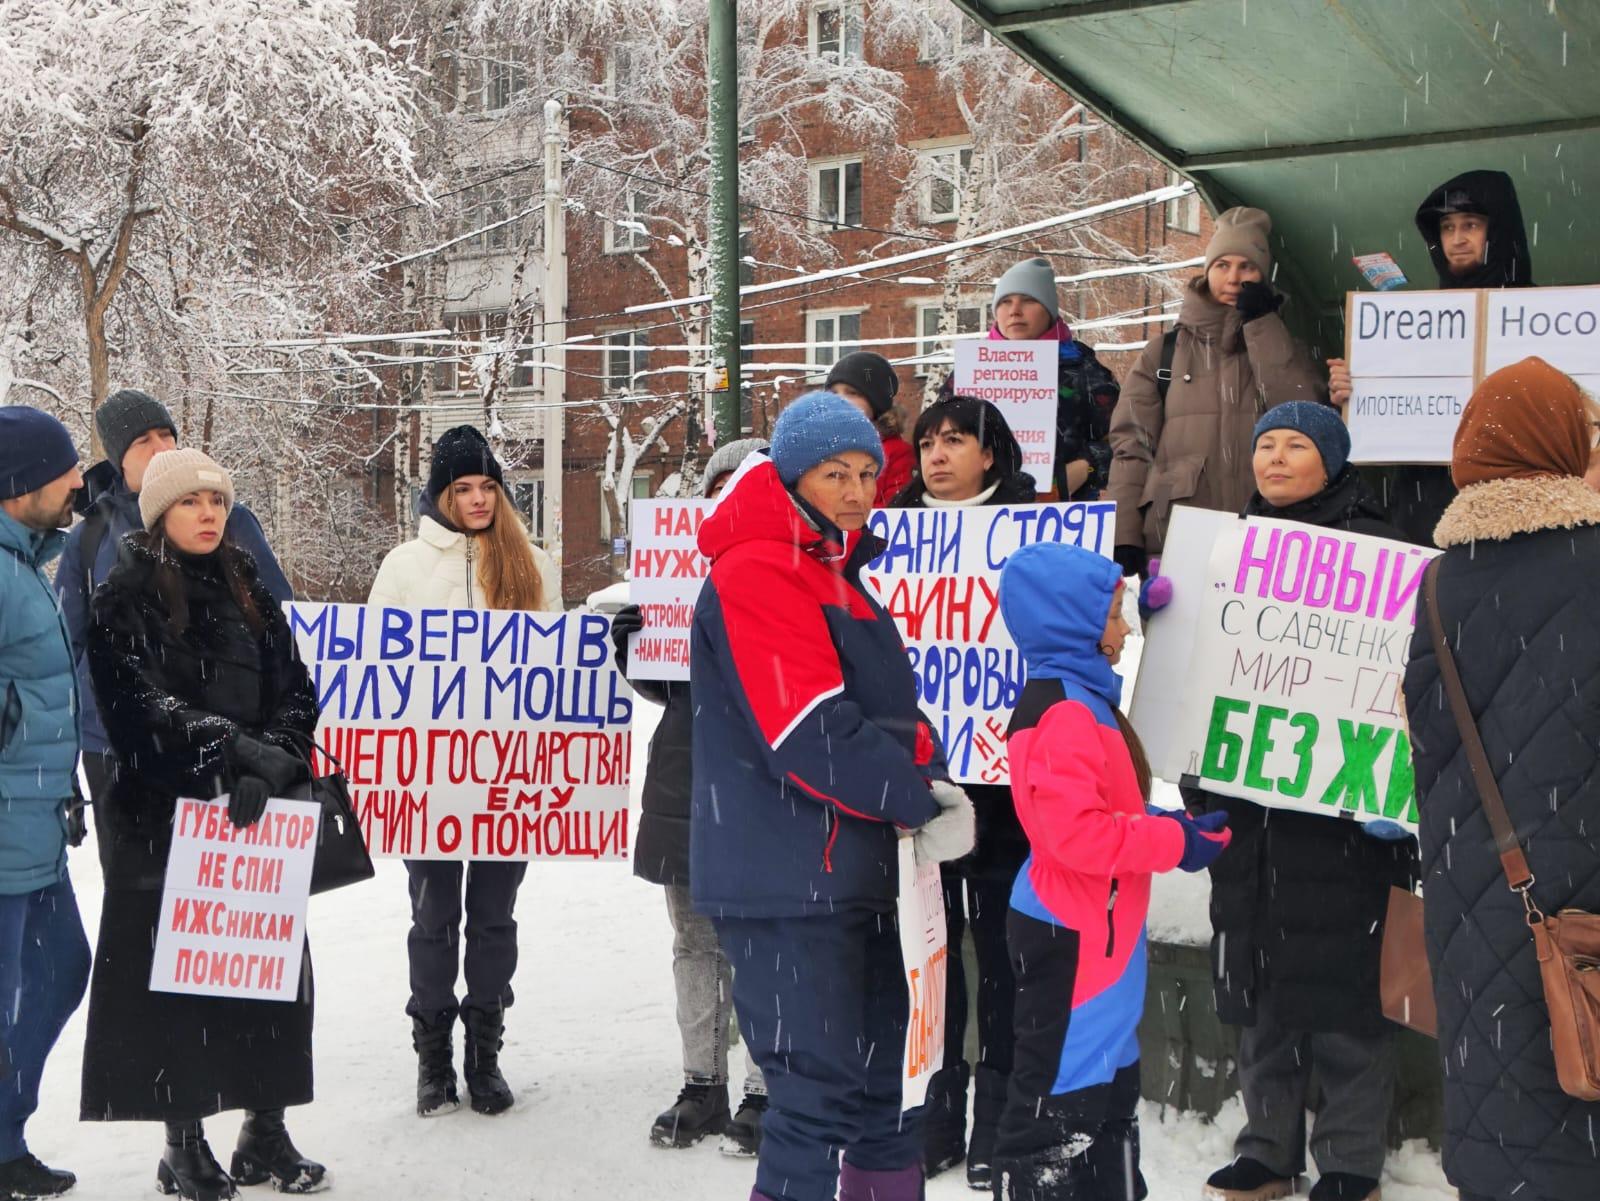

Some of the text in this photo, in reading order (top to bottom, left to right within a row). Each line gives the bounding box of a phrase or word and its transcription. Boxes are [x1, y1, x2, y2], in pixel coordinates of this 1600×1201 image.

[1359, 301, 1466, 340] Dream
[978, 347, 1034, 363] Власти
[956, 387, 1056, 403] игнорируют
[973, 369, 1038, 385] региона
[1356, 395, 1462, 417] ИПОТЕКА ЕСТЬ
[986, 503, 1116, 571] СТОЯТ
[639, 597, 694, 628] ОСТРОЙКА
[1221, 600, 1245, 636] С
[290, 605, 611, 668] МЫ ВЕРИМ В
[664, 637, 690, 667] НЕГД
[314, 664, 633, 729] ИЛУ И МОЩЬ
[1230, 647, 1312, 698] МИР
[1351, 665, 1403, 719] ГД
[426, 728, 633, 786] ГОСУДАРСТВА!
[1201, 695, 1320, 798] БЕЗ
[980, 755, 1009, 783] СТ
[487, 786, 576, 812] ЕМУ
[352, 789, 428, 855] ИЧИМ
[472, 808, 629, 859] ПОМОЩИ!
[197, 851, 285, 894] НЕ СПИ!
[174, 948, 285, 991] ПОМОГИ!
